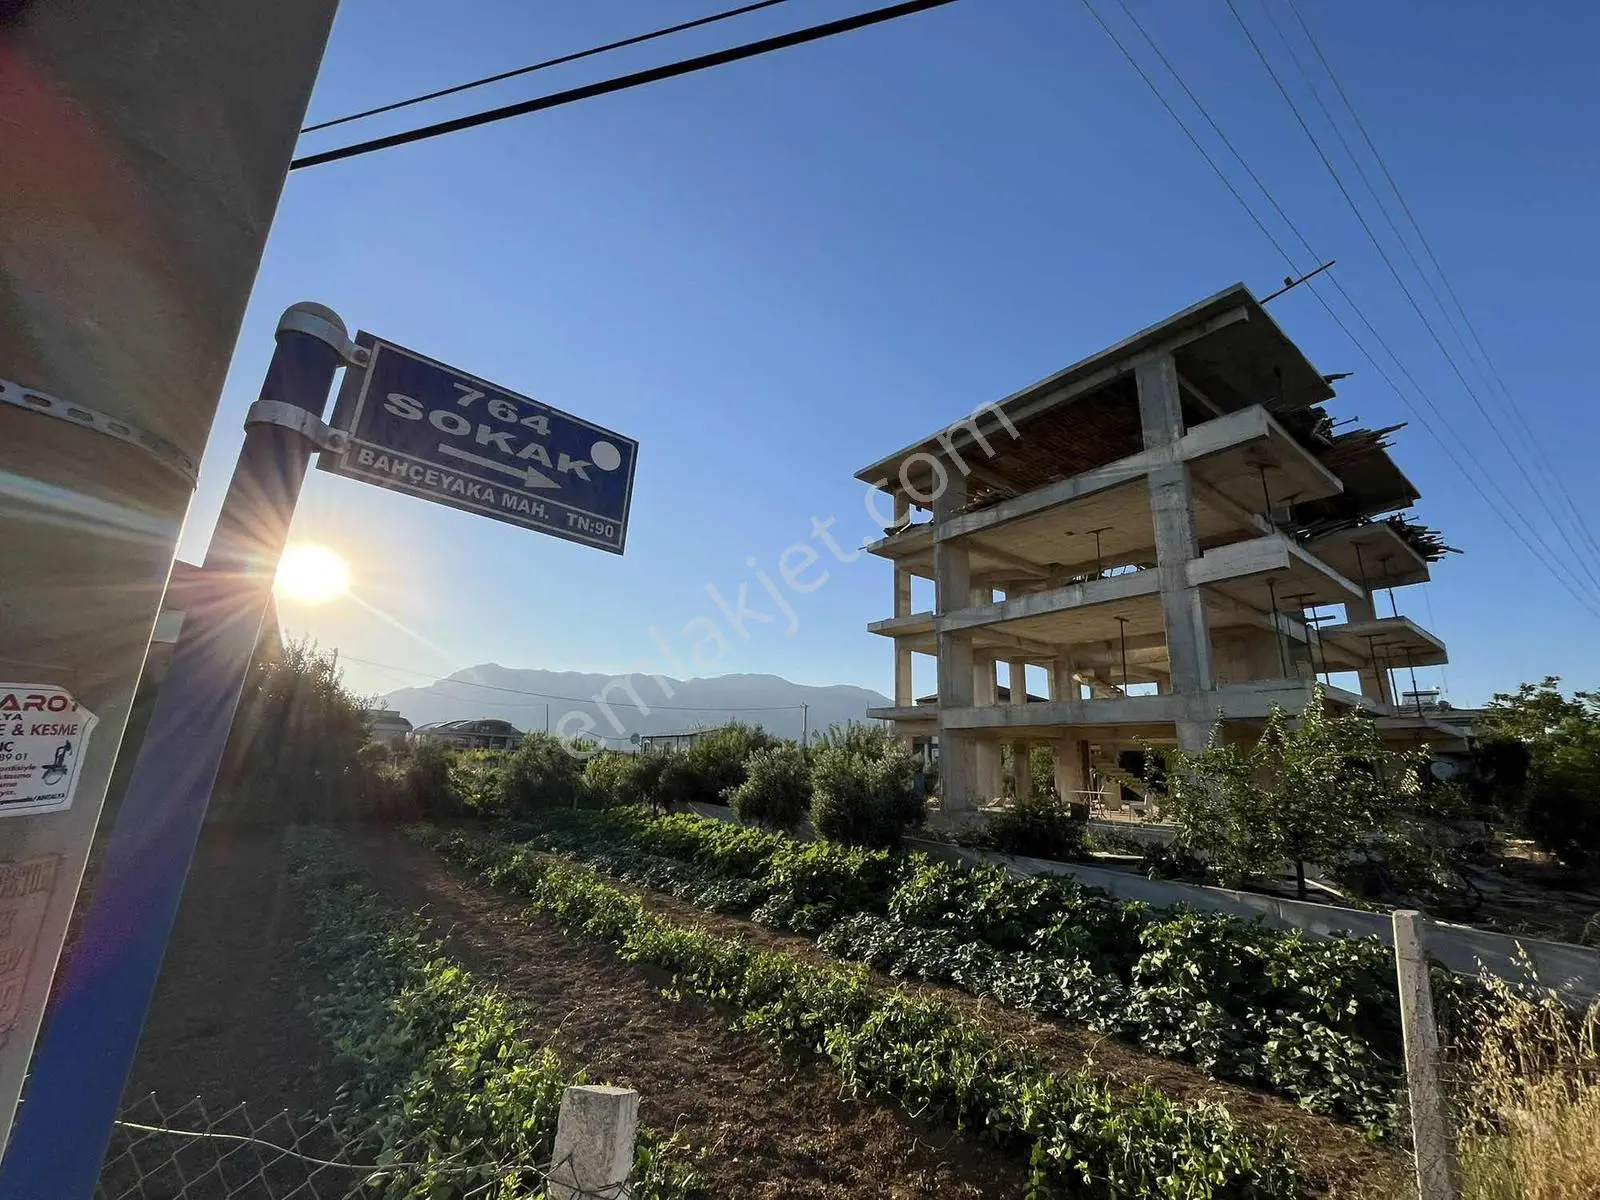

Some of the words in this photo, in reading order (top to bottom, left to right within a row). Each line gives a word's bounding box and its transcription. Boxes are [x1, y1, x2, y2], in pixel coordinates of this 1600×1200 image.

[383, 392, 593, 482] SOKAK
[452, 382, 551, 436] 764
[358, 449, 495, 504] BAHÇEYAKA
[501, 492, 549, 519] MAH.
[566, 512, 615, 539] TN:90
[31, 724, 78, 735] KESME
